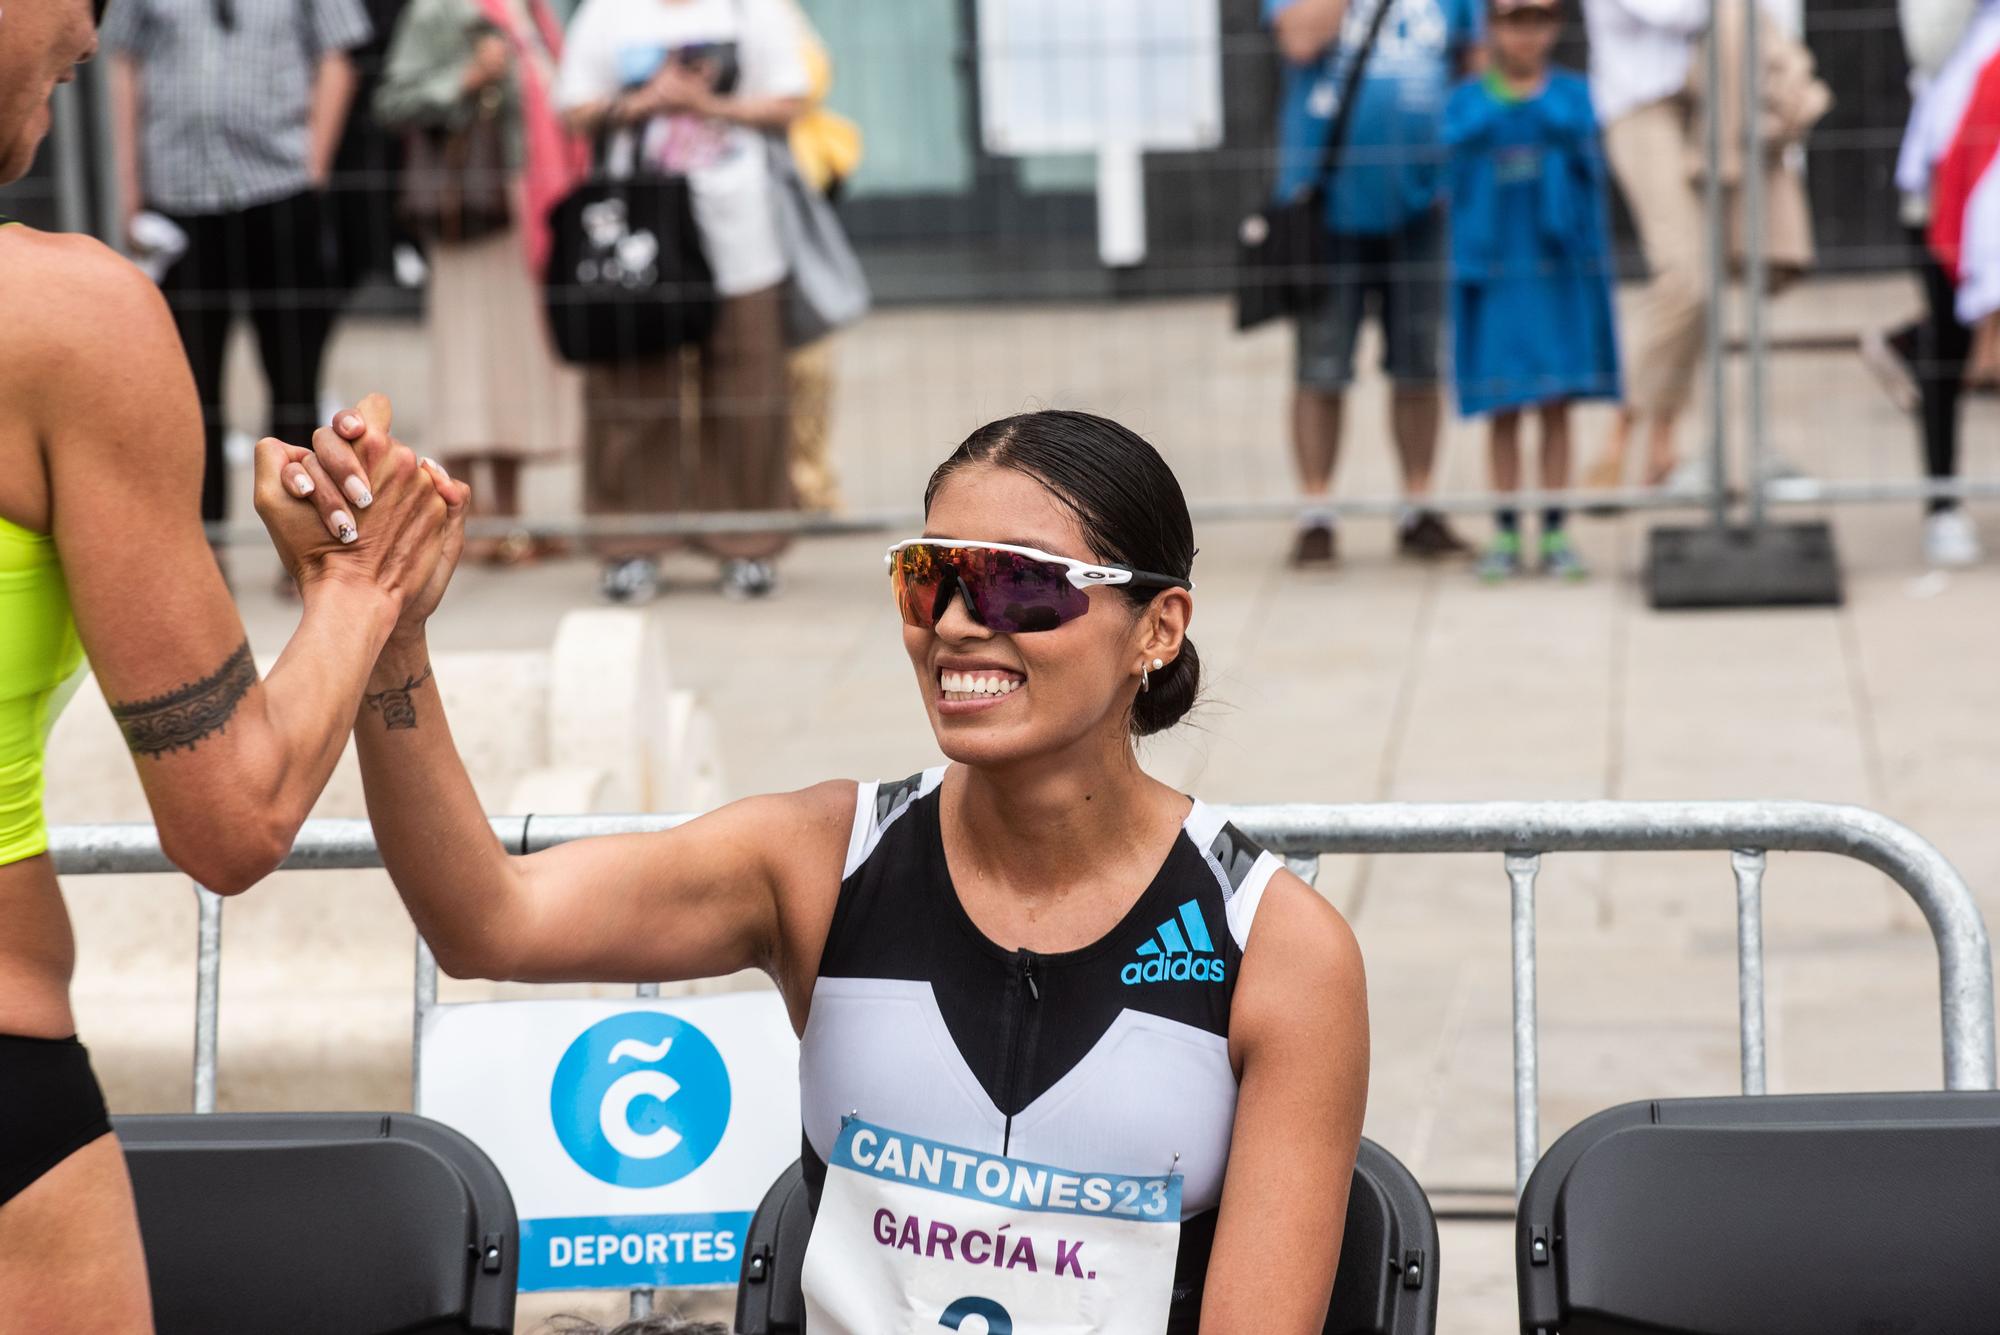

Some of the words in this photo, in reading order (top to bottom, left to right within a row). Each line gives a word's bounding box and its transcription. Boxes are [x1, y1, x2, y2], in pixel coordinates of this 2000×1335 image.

[1120, 951, 1225, 985] adidas
[850, 1128, 1169, 1217] CANTONES23
[549, 1231, 737, 1268] DEPORTES
[872, 1207, 1038, 1273] GARCÍA
[1054, 1239, 1097, 1280] K.
